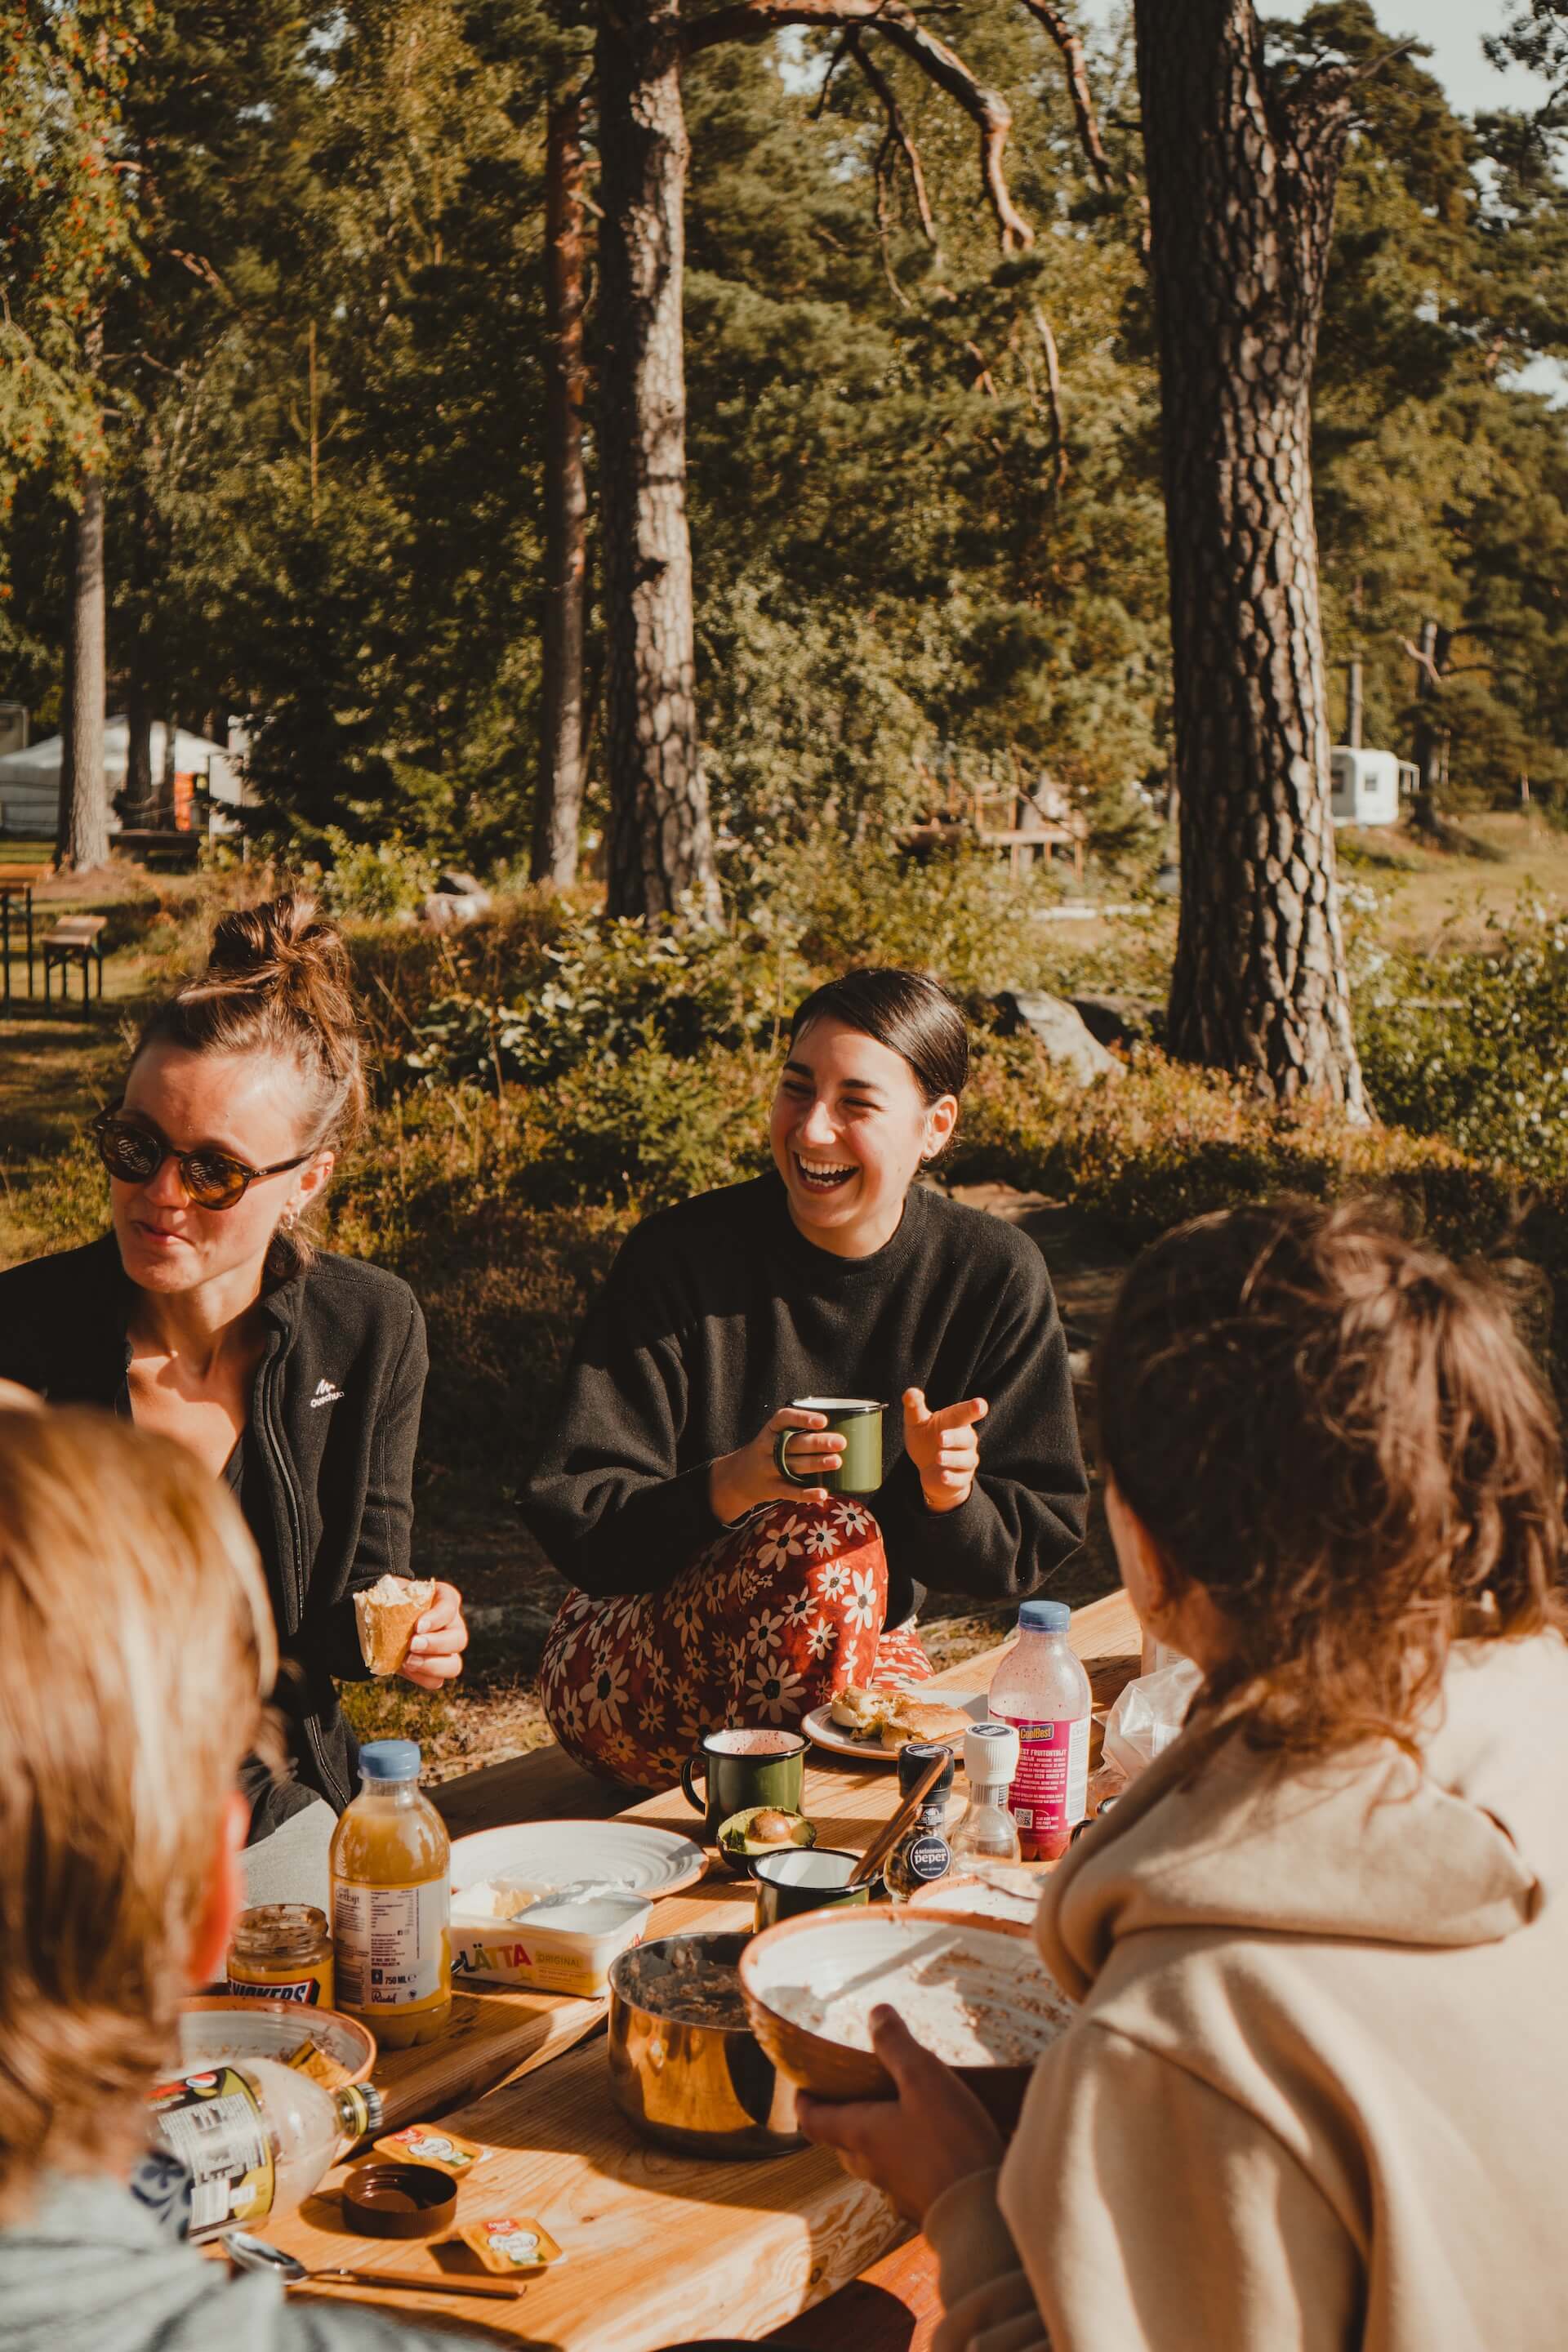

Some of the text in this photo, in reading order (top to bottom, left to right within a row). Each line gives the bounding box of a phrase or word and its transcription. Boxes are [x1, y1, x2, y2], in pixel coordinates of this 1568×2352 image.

[1020, 1727, 1051, 1740] CoolBest
[914, 1854, 947, 1864] peper
[459, 1943, 532, 1973] LÄTTA
[537, 1953, 582, 1967] ORIGINAL
[385, 1976, 407, 1984] 750 ML
